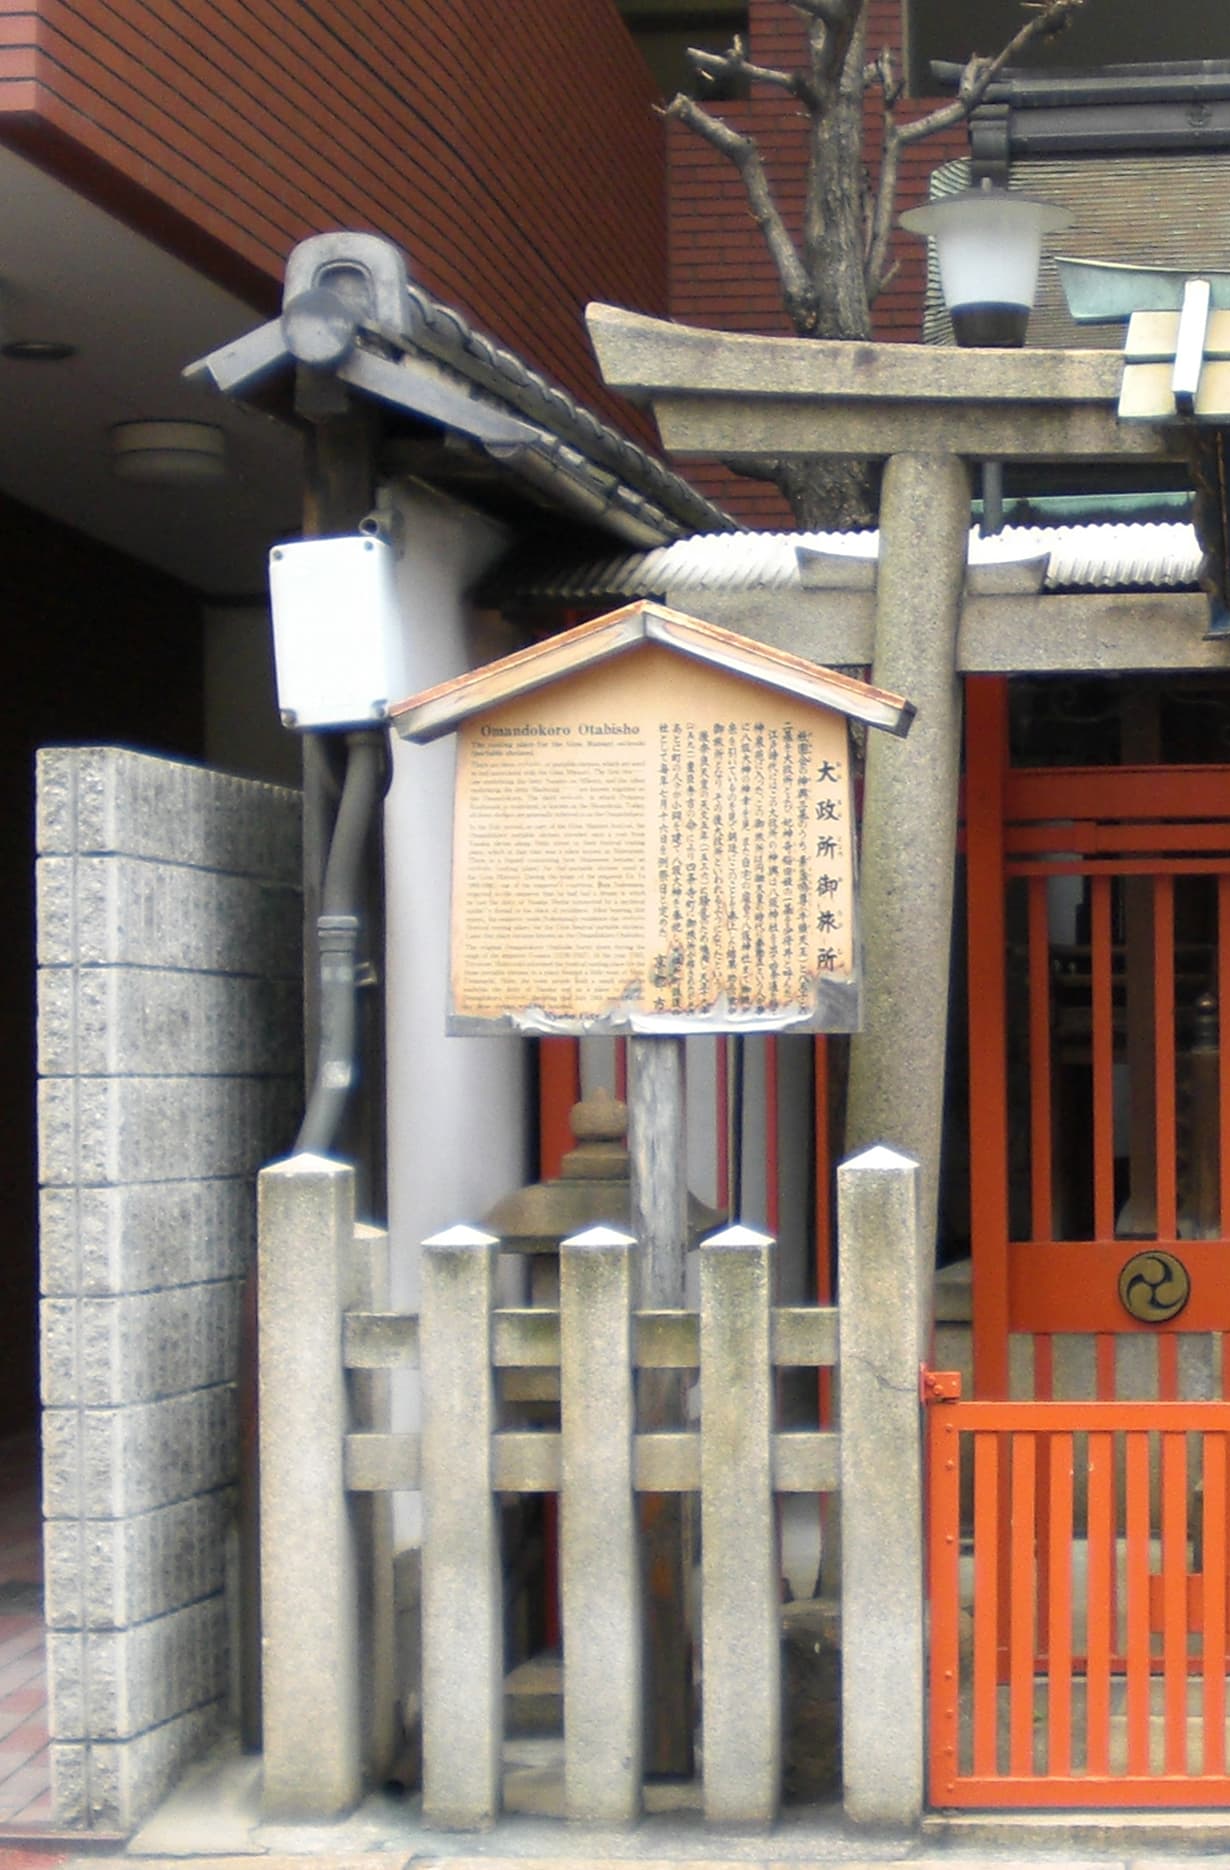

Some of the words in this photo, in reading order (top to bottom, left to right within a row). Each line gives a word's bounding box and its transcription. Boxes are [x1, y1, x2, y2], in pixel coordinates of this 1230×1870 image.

[481, 724, 571, 737] Omandokoro
[578, 722, 640, 736] Otabisho
[815, 760, 842, 972] 大政所御旅所
